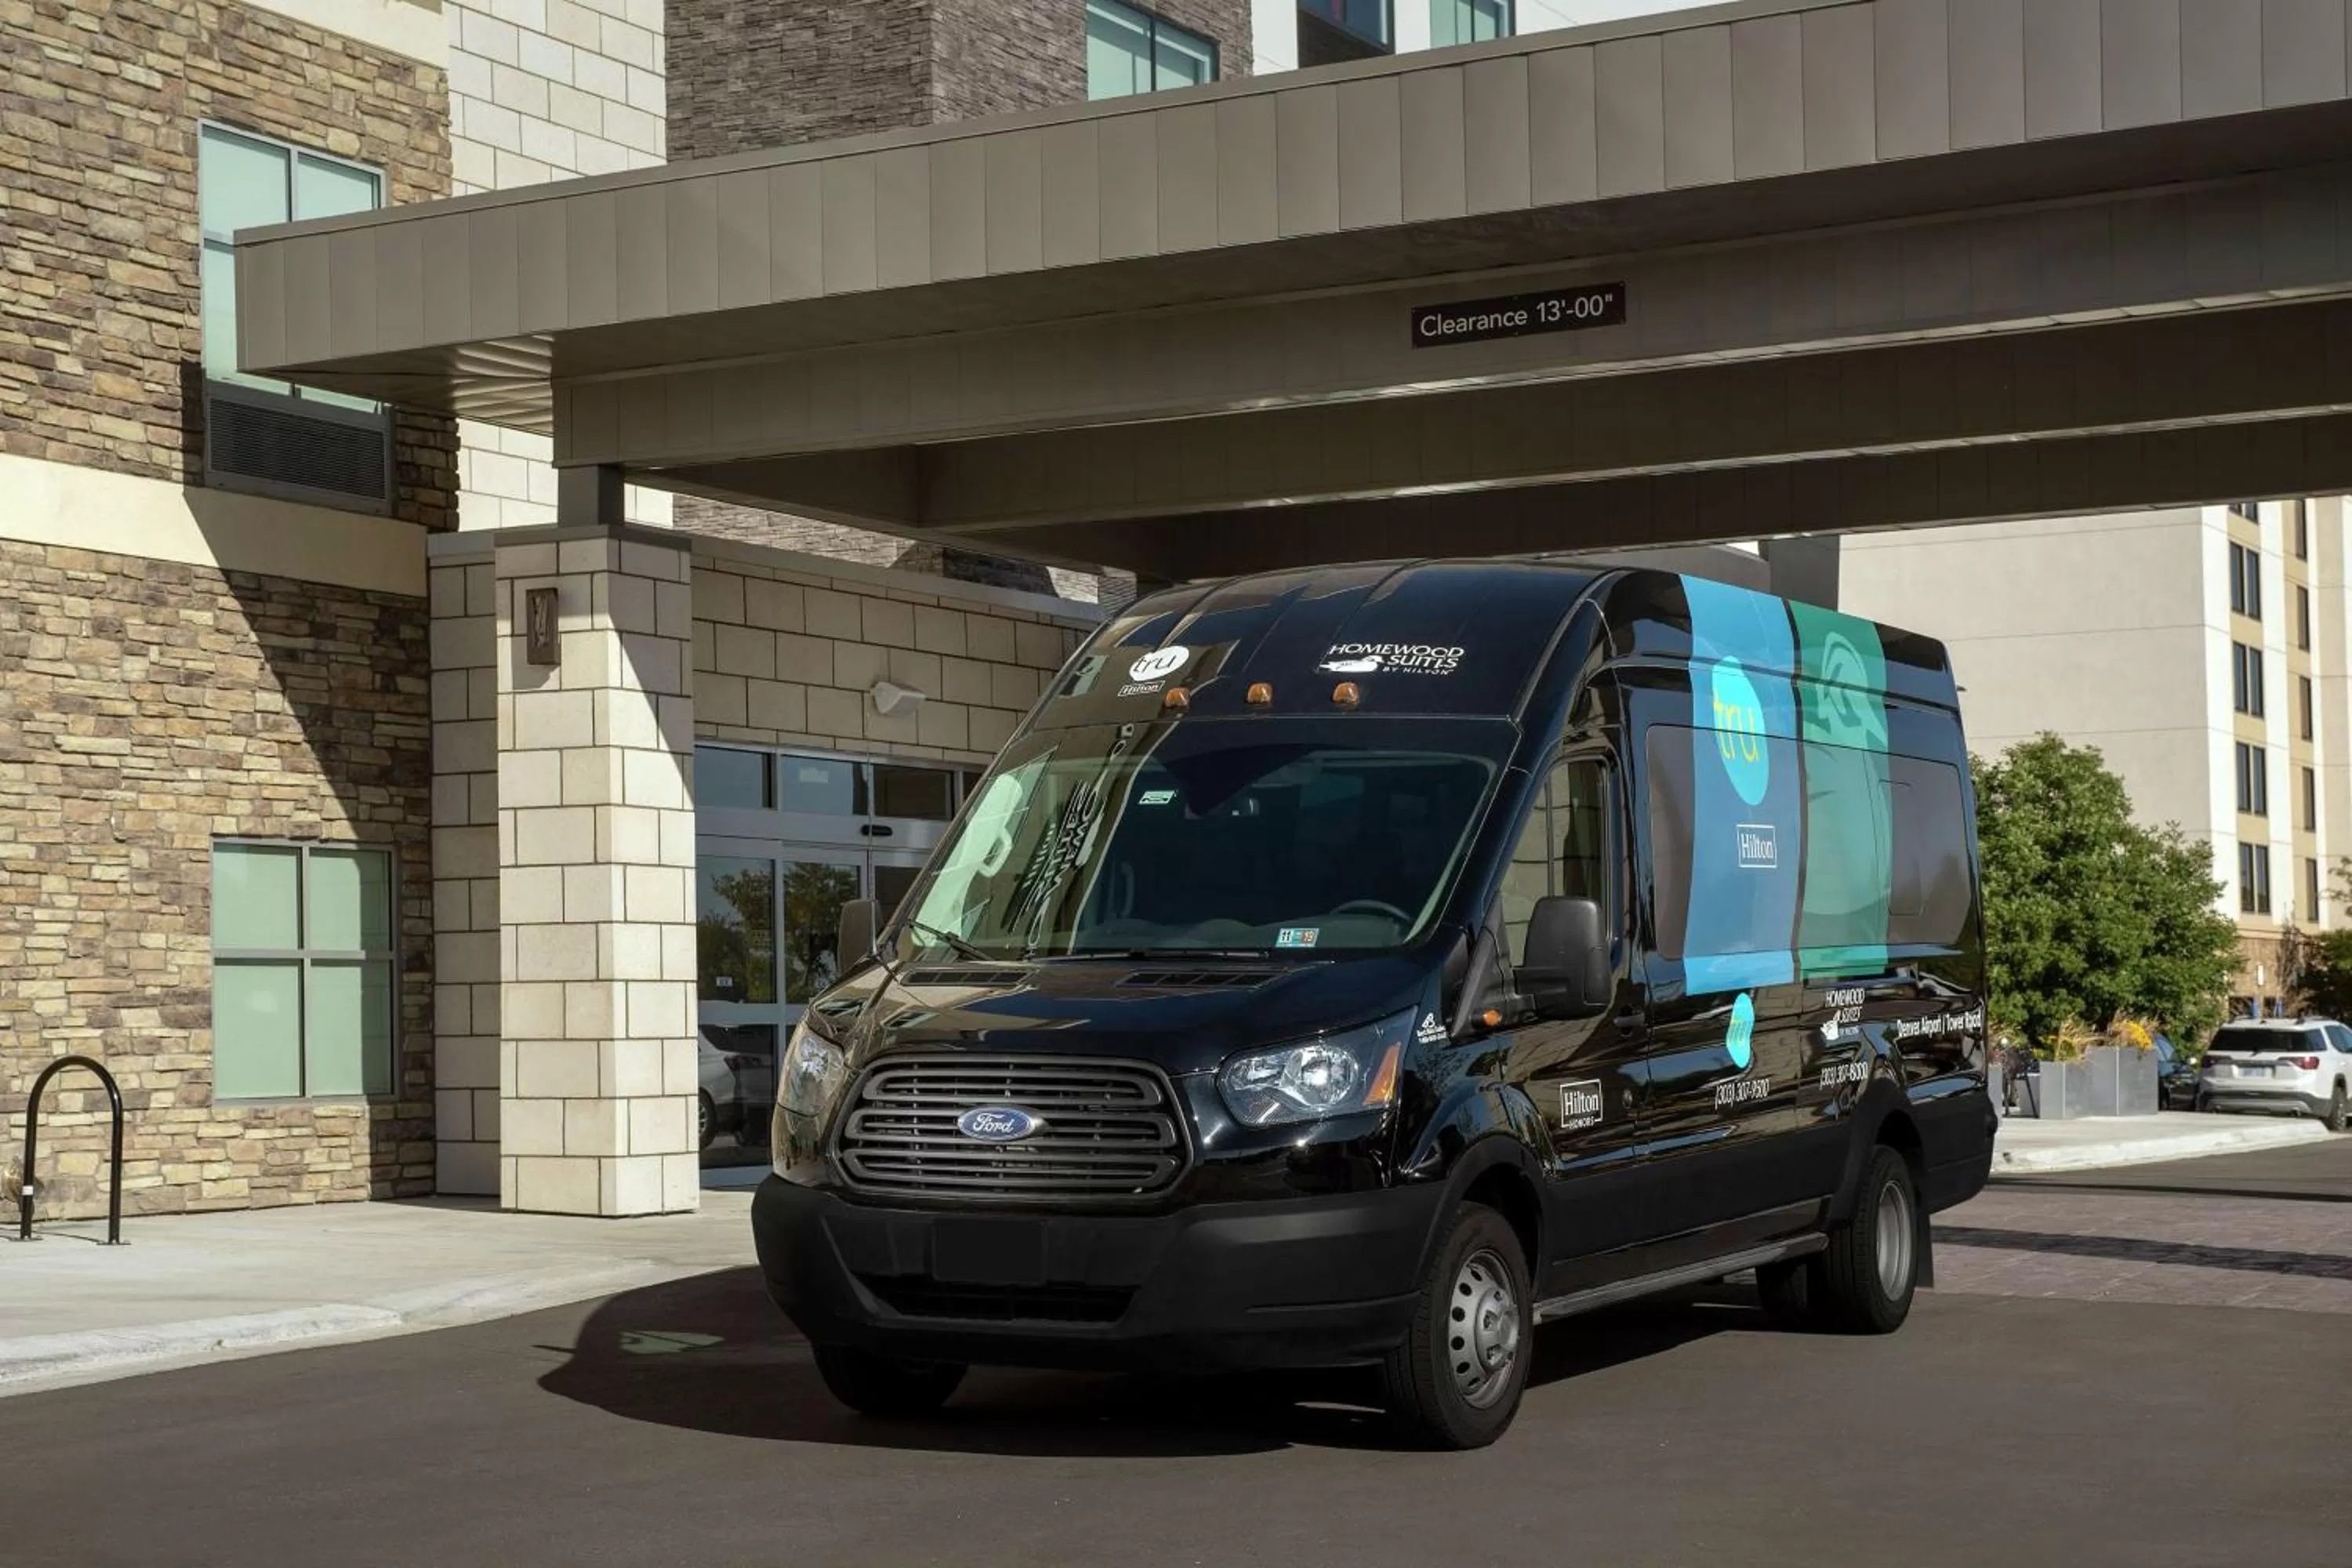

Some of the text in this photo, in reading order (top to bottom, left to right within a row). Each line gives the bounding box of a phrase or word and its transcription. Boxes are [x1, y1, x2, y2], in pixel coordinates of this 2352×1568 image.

[1420, 310, 1528, 336] Clearance
[1330, 644, 1464, 658] HOMEWOOD
[1387, 655, 1459, 669] SUITES
[1133, 655, 1177, 673] tru
[1713, 695, 1759, 763] tru
[1741, 833, 1773, 859] Hilton
[1825, 988, 1865, 1007] HOMEWOOD
[1897, 1019, 1920, 1036] Denver
[1946, 1013, 1964, 1031] Tower
[1564, 1091, 1599, 1115] Hilton
[973, 1112, 1016, 1134] Ford
